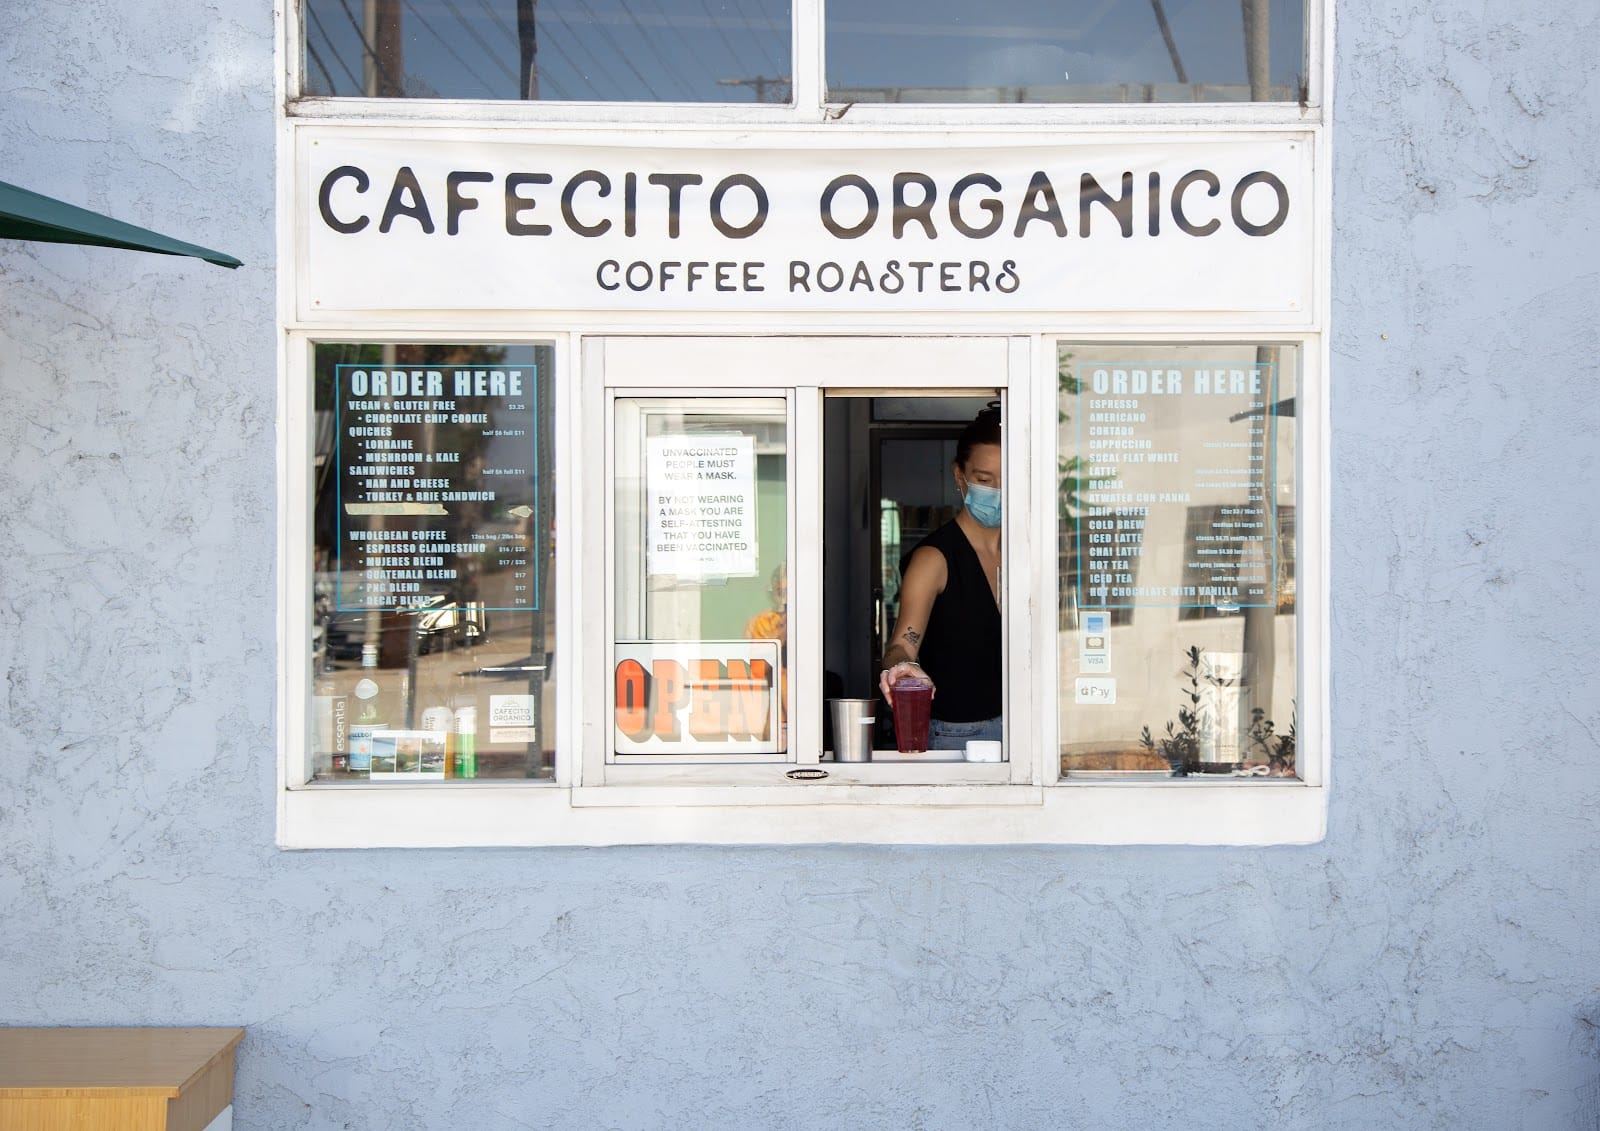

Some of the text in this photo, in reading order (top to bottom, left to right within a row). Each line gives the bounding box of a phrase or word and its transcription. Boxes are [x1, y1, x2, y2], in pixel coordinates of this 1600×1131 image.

[318, 165, 1290, 240] CAFECITO ORGANICO
[596, 259, 1021, 294] COFFEE ROASTERS
[351, 370, 523, 397] ORDER HERE
[1093, 369, 1262, 395] ORDER HERE
[348, 400, 456, 410] VEGAN & GLUTEN FREE
[1089, 399, 1139, 409] ESPRESSO
[365, 413, 488, 423] CHOCOLATE CHIP COOKIE
[1089, 412, 1147, 422] AMERICANO
[348, 427, 393, 437] QUICHES
[1089, 426, 1134, 436] CORTADO
[365, 440, 414, 450] LORRAINE
[1089, 439, 1152, 449] CAPPUCCINO
[662, 447, 738, 457] UNVACCINATED
[365, 453, 460, 463] MUSHROOM & KALE
[1089, 453, 1179, 463] SOCAL FLAT WHITE
[665, 459, 736, 469] PEOPLE MUST
[349, 466, 416, 476] SANDWICHES
[1089, 466, 1118, 476] LATTE
[664, 472, 737, 481] WEAR A MASK.
[365, 479, 450, 489] HAM AND CHEESE
[1089, 480, 1124, 490] MOCHA
[366, 491, 496, 501] TURKEY & BRIE SANDWICH
[658, 495, 744, 505] BY NOT WEARING
[1088, 493, 1133, 503] ATWATER
[659, 506, 744, 517] A MASK YOU ARE
[1088, 506, 1150, 517] DRIP COFFEE
[661, 519, 742, 529] SELF-ATTESTING
[1088, 520, 1145, 530] COLD BREW
[349, 530, 447, 541] WHOLEBEAN COFFEE
[663, 530, 741, 541] THAT YOU HAVE
[1089, 533, 1144, 544] ICED LATTE
[366, 543, 486, 554] ESPRESSO CLANDESTINO
[656, 542, 748, 552] BEEN VACCINATED
[1089, 547, 1145, 557] CHAI LATTE
[366, 556, 444, 567] MUJERES BLEND
[1089, 560, 1129, 570] HOT TEA
[366, 569, 457, 580] GUATEMALA BLEND
[1090, 573, 1133, 584] ICED TEA
[366, 583, 420, 593] PNG BLEND
[1090, 586, 1239, 597] HOT CHOCOLATE WITH VANILLA
[366, 595, 431, 606] DECAF BLEND
[1087, 657, 1104, 665] VISA
[1090, 686, 1110, 699] Pay
[616, 659, 772, 743] OPEN
[335, 701, 345, 752] essentia
